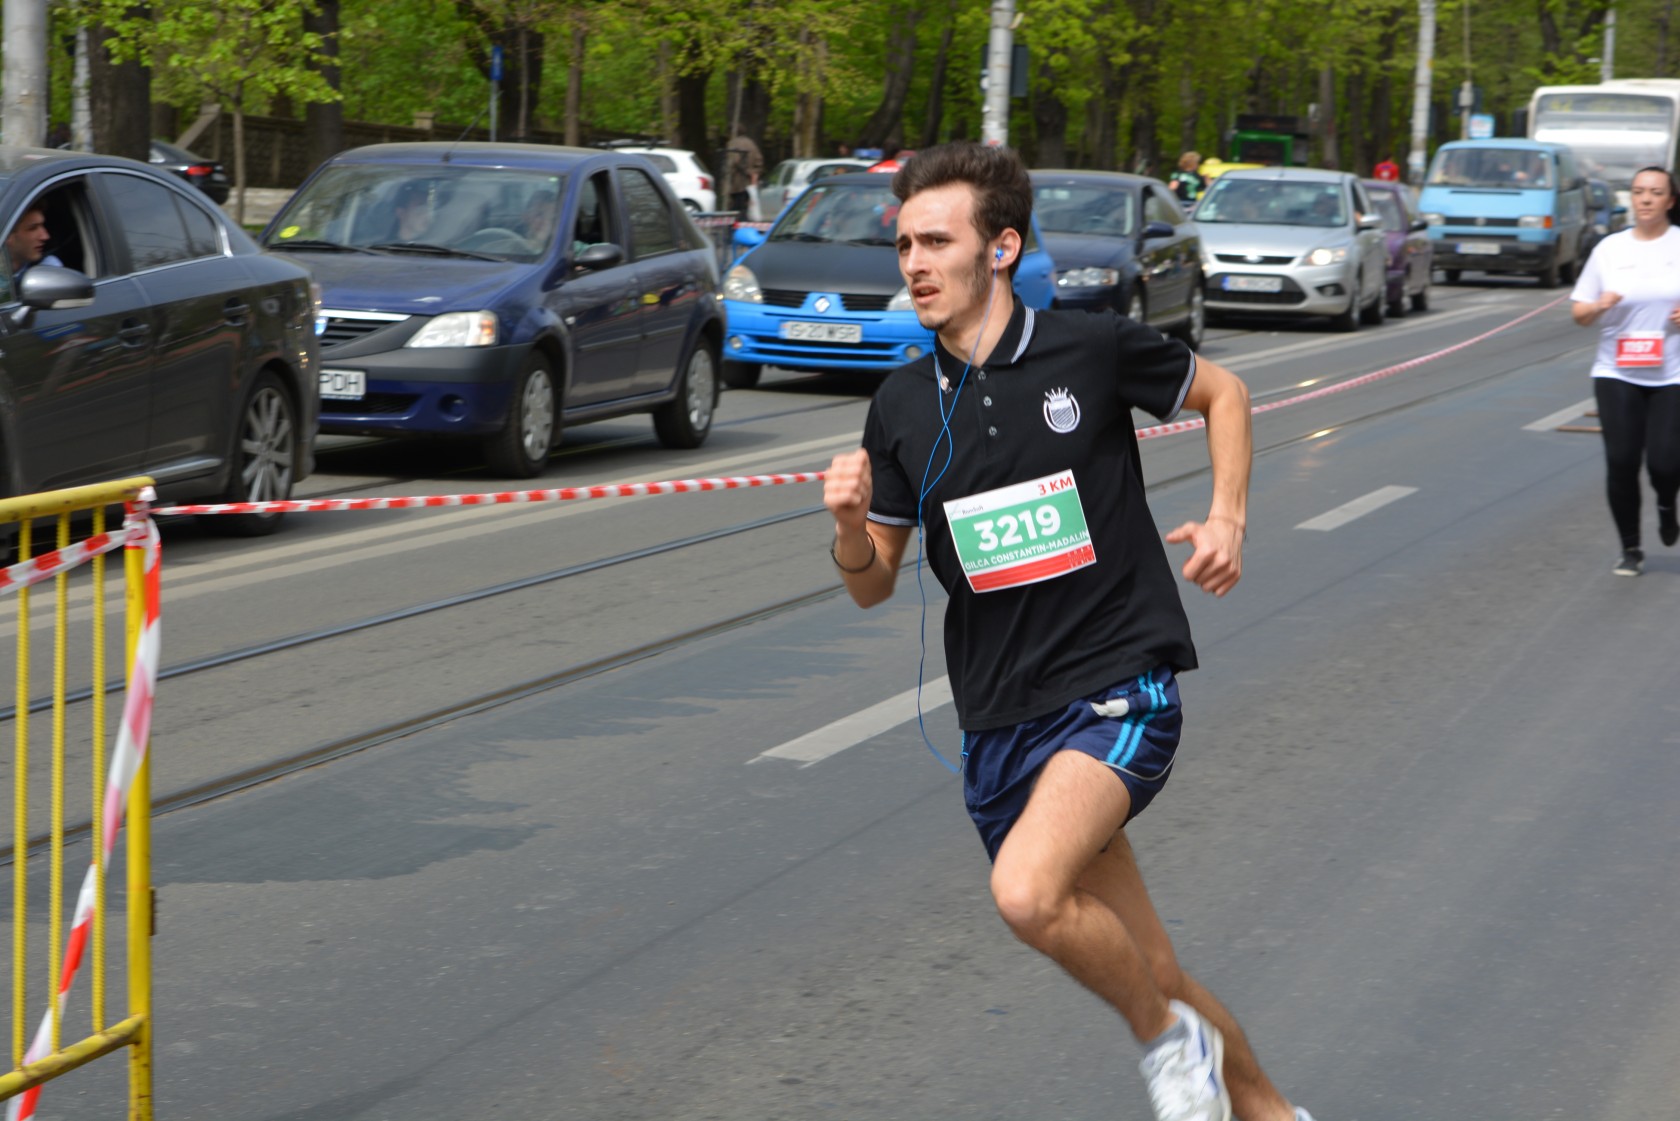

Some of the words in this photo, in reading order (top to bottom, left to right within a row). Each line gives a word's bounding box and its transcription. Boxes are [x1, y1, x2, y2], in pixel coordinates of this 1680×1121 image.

[1038, 484, 1046, 496] 3
[1050, 476, 1073, 493] KM
[973, 504, 1061, 552] 3219
[965, 558, 990, 571] GILCA
